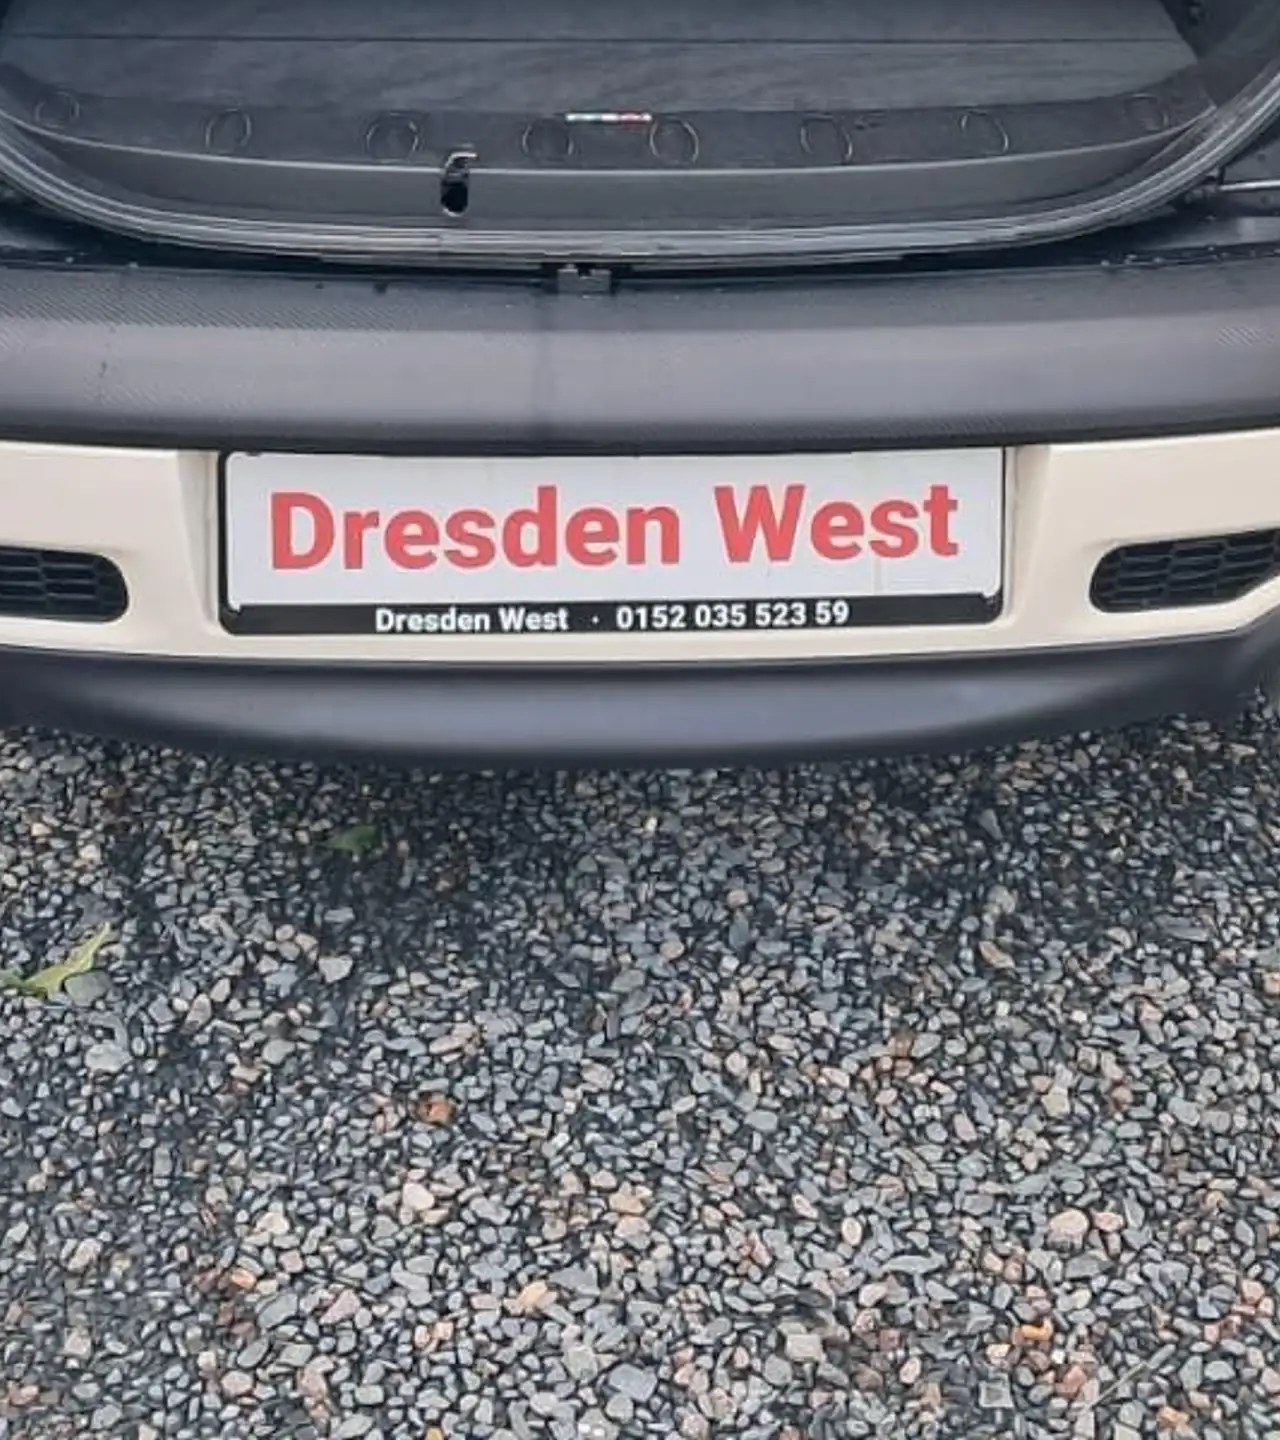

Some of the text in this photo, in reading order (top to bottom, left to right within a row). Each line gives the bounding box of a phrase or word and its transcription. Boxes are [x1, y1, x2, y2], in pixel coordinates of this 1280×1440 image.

[271, 483, 958, 571] Dresden West
[375, 600, 850, 632] Dresden West 0152 035 523 59
